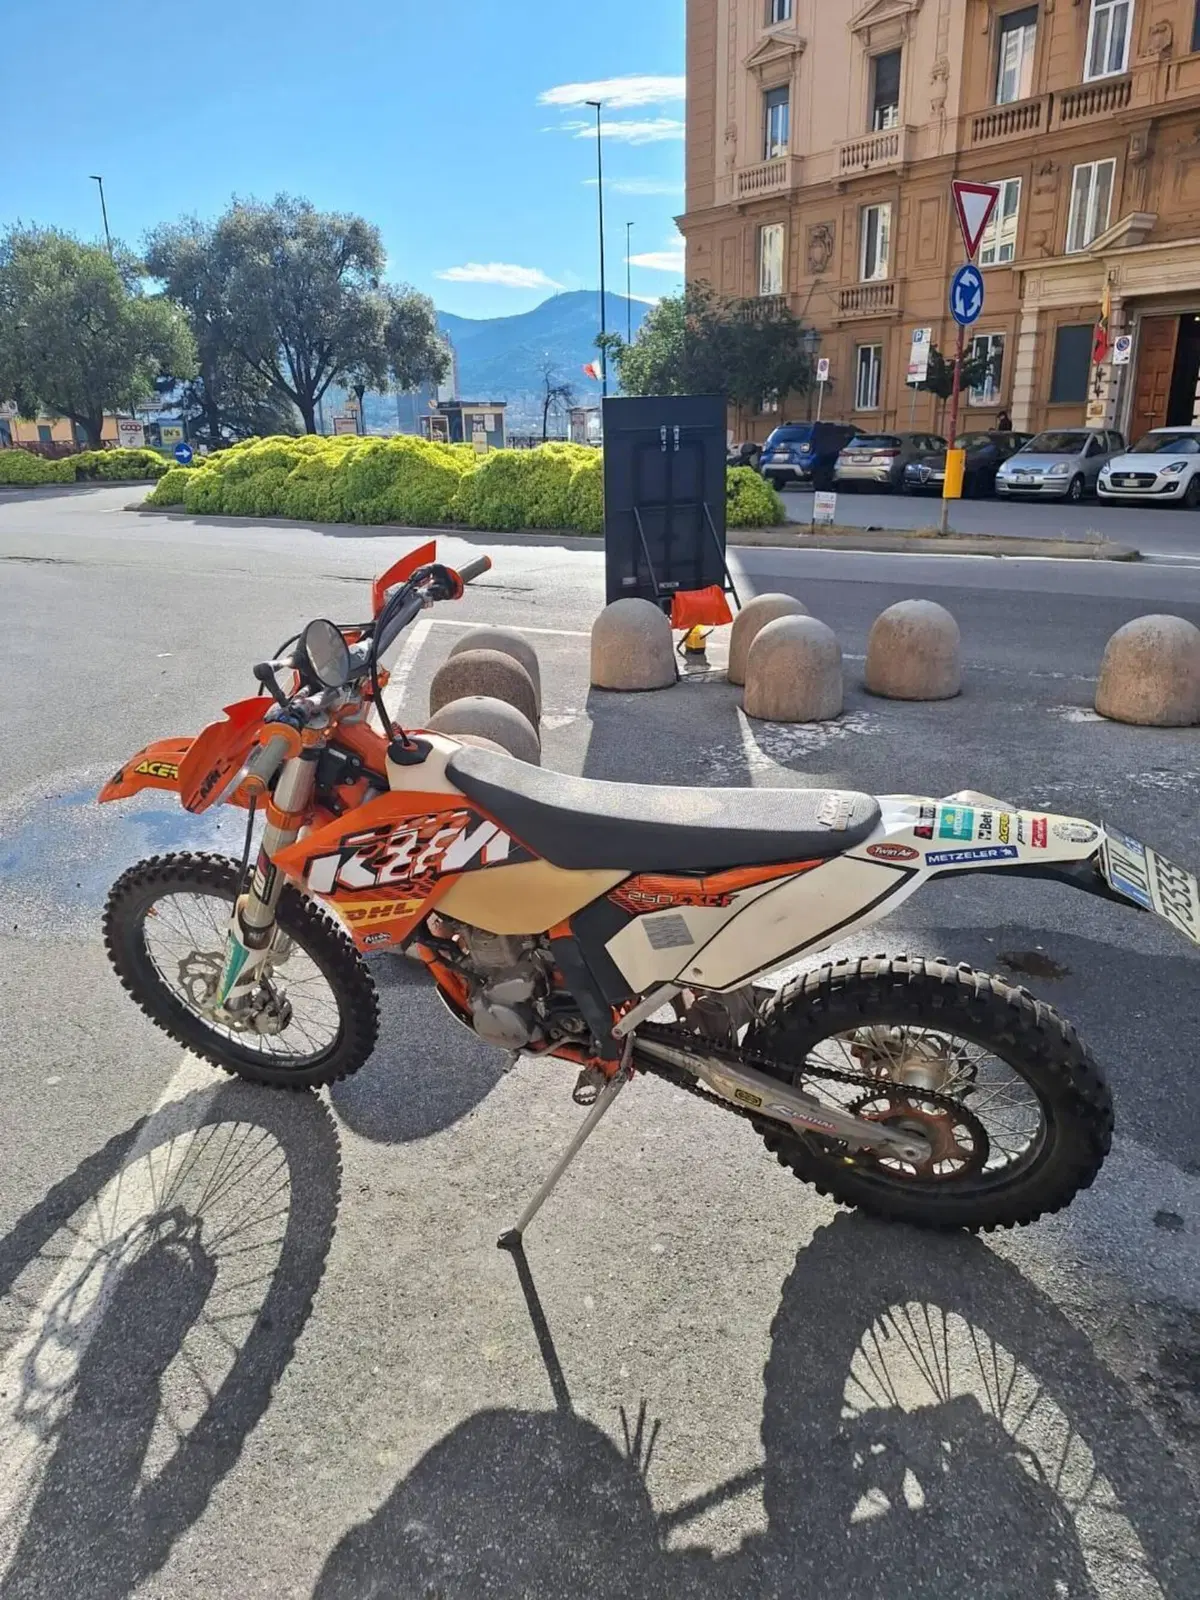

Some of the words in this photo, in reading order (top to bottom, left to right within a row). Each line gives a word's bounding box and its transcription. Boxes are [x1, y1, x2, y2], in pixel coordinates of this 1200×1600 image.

[307, 812, 511, 893] KTM
[874, 846, 898, 857] Twin
[897, 849, 913, 857] Air
[928, 849, 997, 863] METZELER
[1111, 848, 1148, 891] DV
[628, 890, 674, 904] 250
[1153, 852, 1197, 939] 73333
[344, 902, 413, 921] DHL
